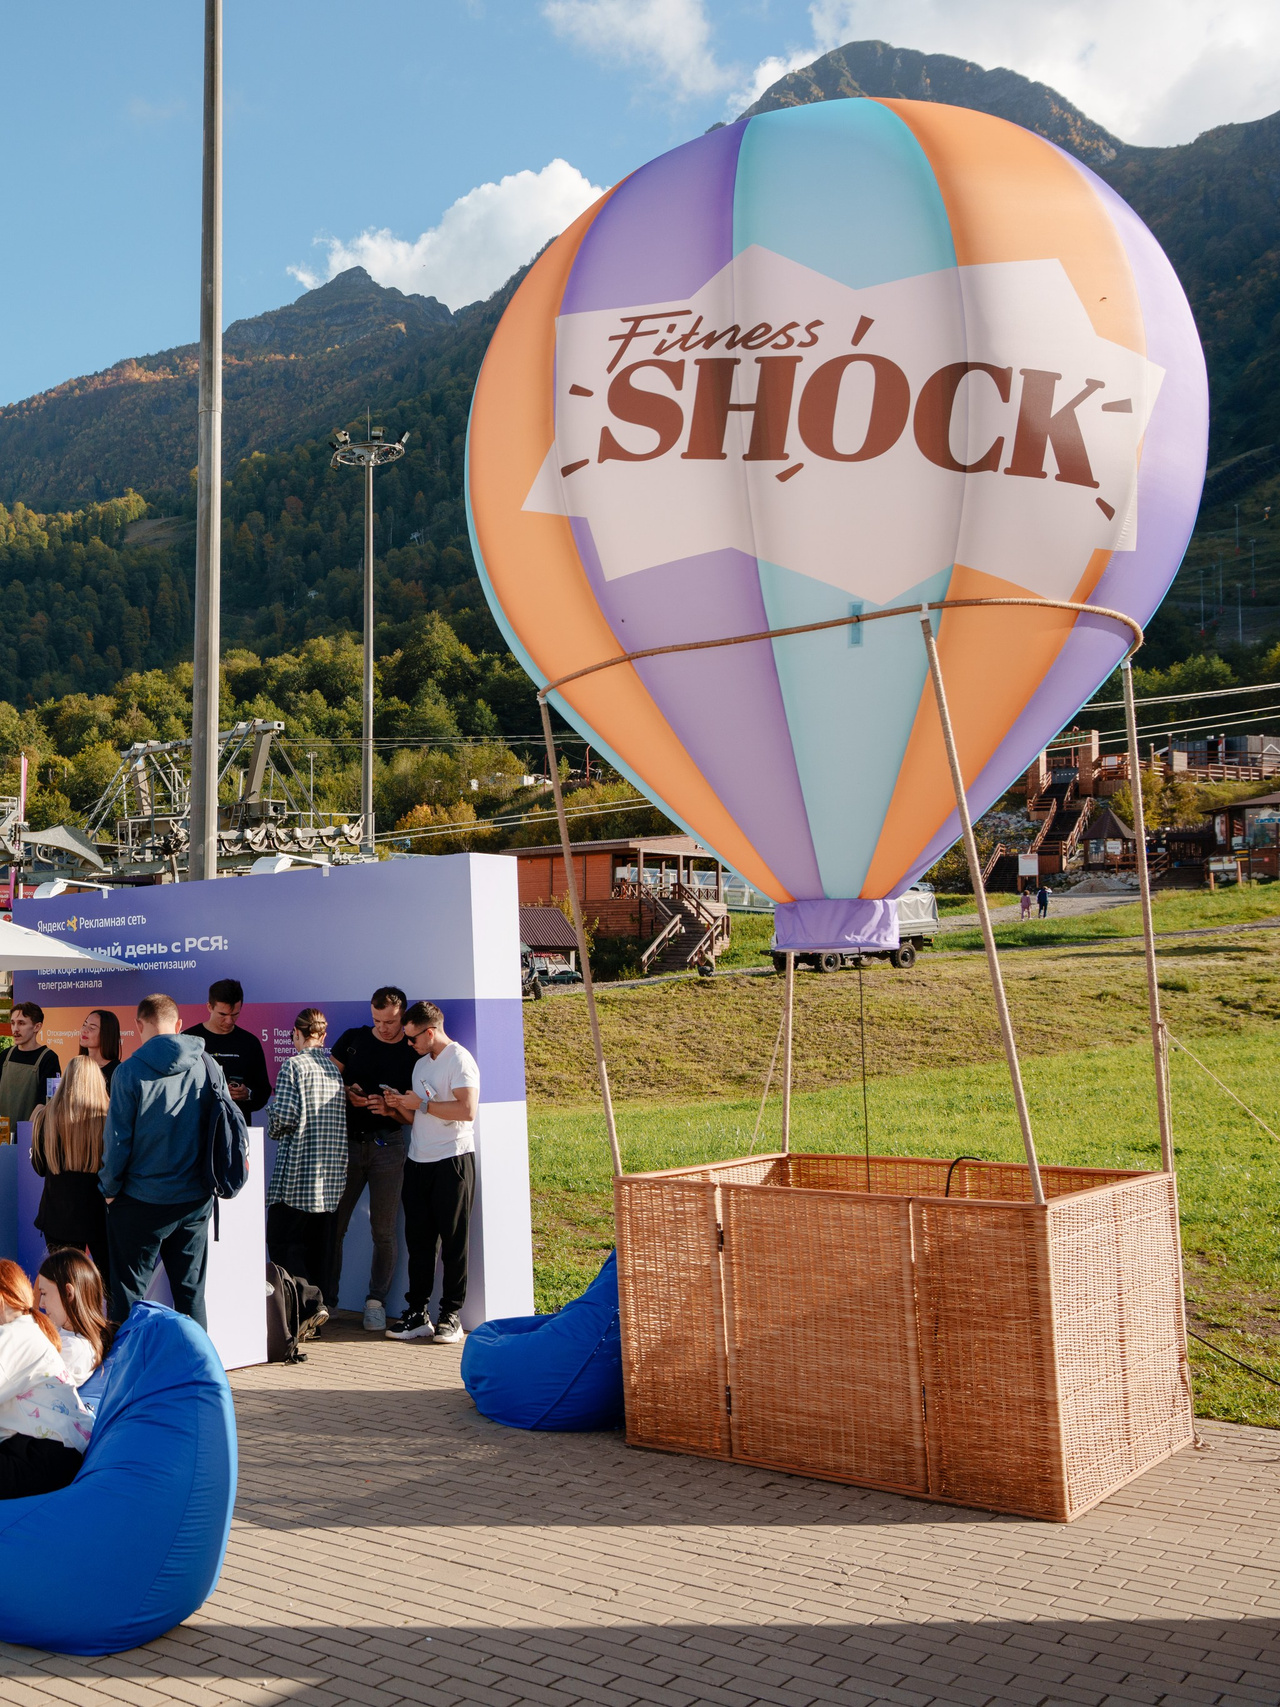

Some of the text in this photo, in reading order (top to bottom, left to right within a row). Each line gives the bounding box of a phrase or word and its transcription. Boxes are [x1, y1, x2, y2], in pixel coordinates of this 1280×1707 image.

[606, 310, 824, 374] Fitness
[597, 353, 1106, 489] SHOCK
[37, 914, 147, 933] Яндекс Рекламная сеть
[125, 943, 167, 958] день
[171, 941, 181, 953] с
[185, 935, 229, 952] РСЯ:
[137, 959, 197, 971] монетизацию
[38, 979, 103, 991] телеграм-канала
[39, 1030, 43, 1041] 1
[261, 1028, 291, 1042] 5 Подк
